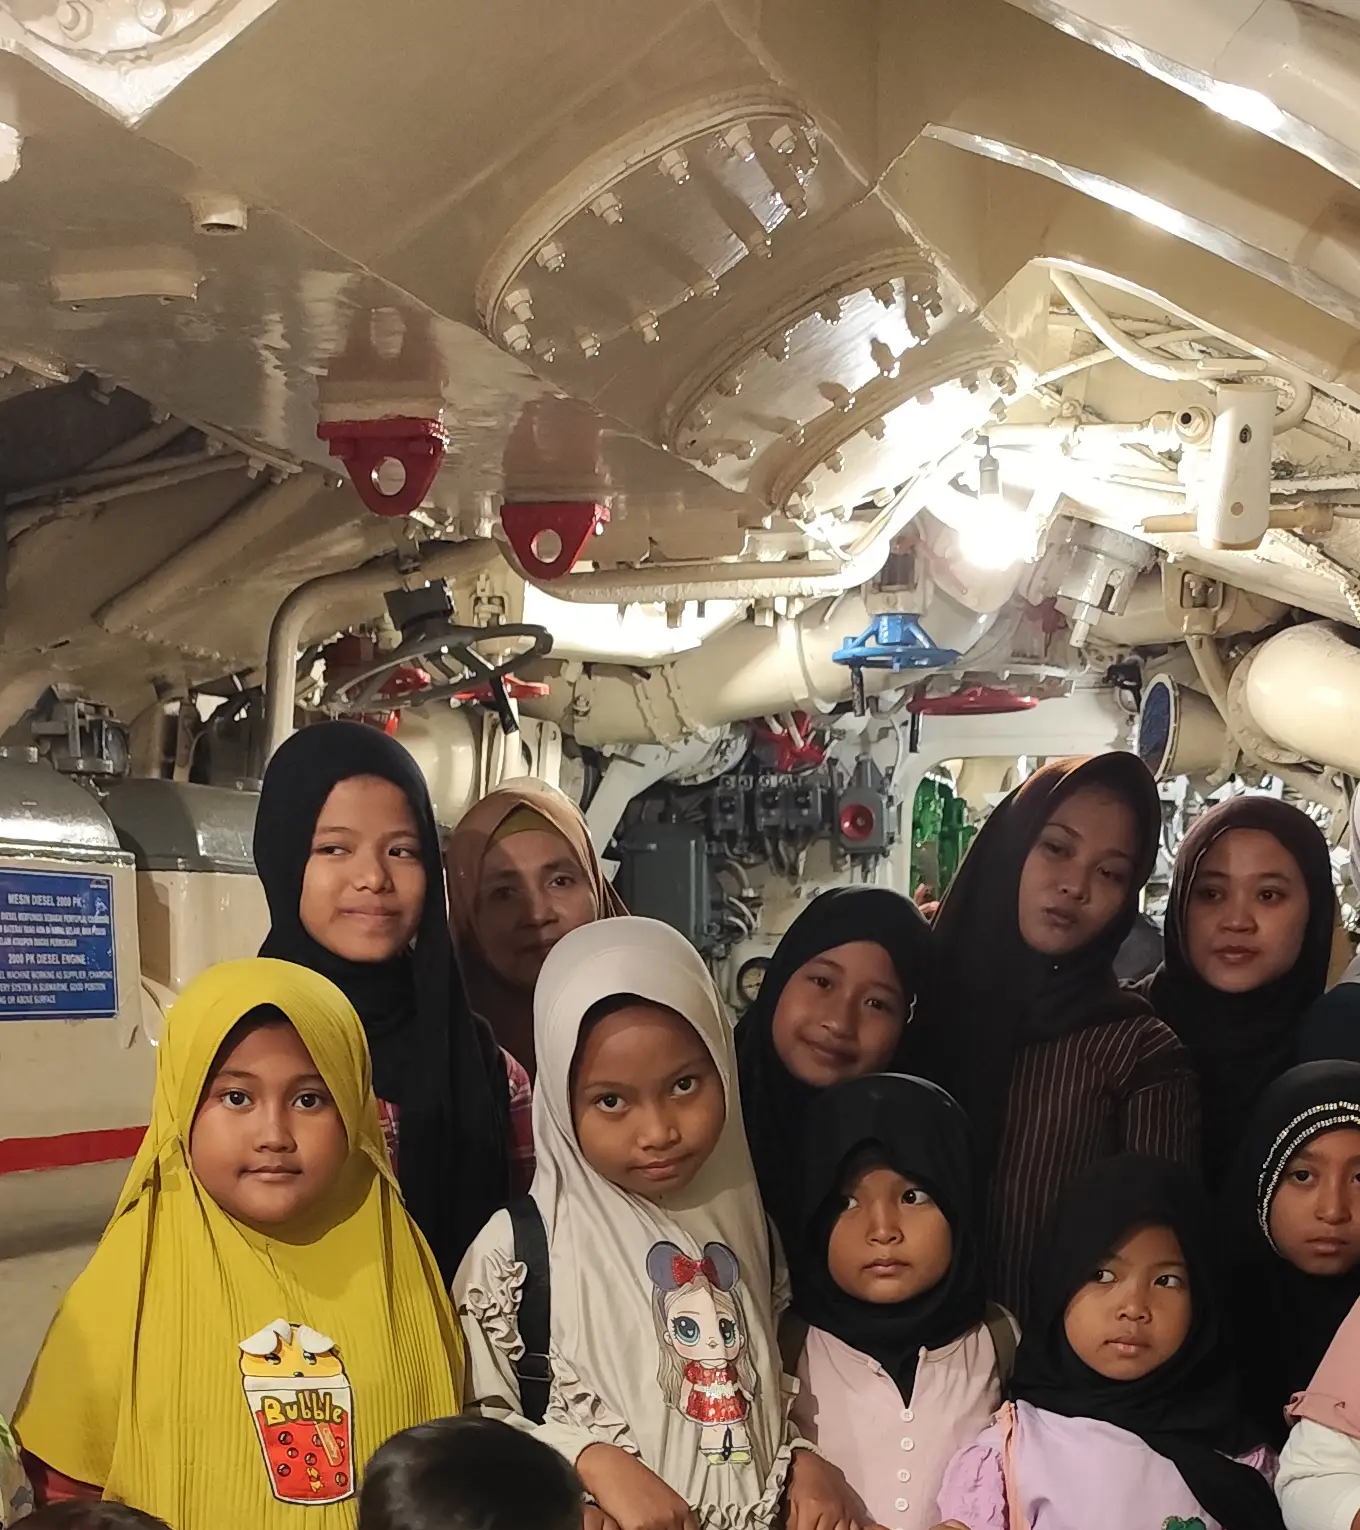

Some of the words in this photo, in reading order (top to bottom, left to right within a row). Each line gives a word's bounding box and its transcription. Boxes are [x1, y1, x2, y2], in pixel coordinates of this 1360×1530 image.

[7, 893, 31, 905] MESIN
[31, 894, 55, 907] DIESEL
[56, 896, 72, 907] 2000
[8, 953, 24, 965] 2000
[25, 953, 36, 965] PK
[36, 954, 60, 965] DIESEL
[61, 954, 86, 965] ENGINE
[261, 1390, 344, 1427] Bubble
